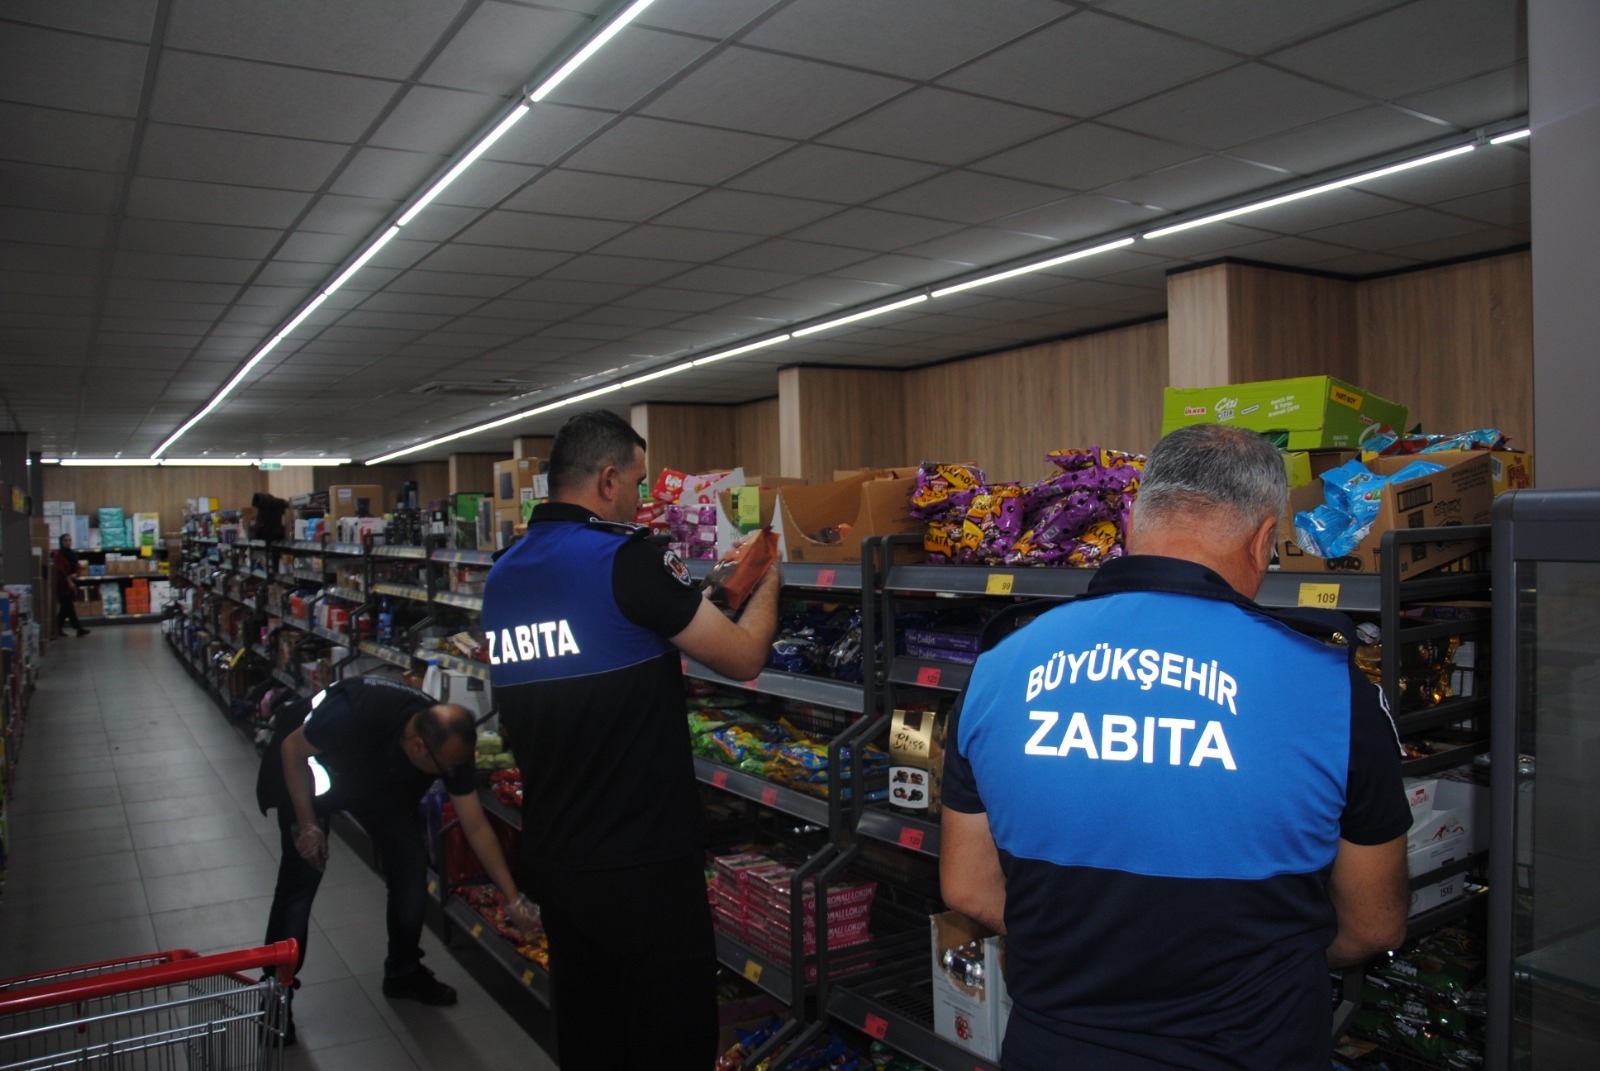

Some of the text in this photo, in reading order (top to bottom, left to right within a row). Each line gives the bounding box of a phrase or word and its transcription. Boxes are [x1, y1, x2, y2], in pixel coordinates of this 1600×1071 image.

[1002, 582, 1011, 591] 99
[1317, 593, 1336, 604] 109
[485, 619, 581, 665] ZABITA
[1025, 642, 1238, 716] BÜYÜKŞEHİR
[1024, 710, 1238, 771] ZABITA
